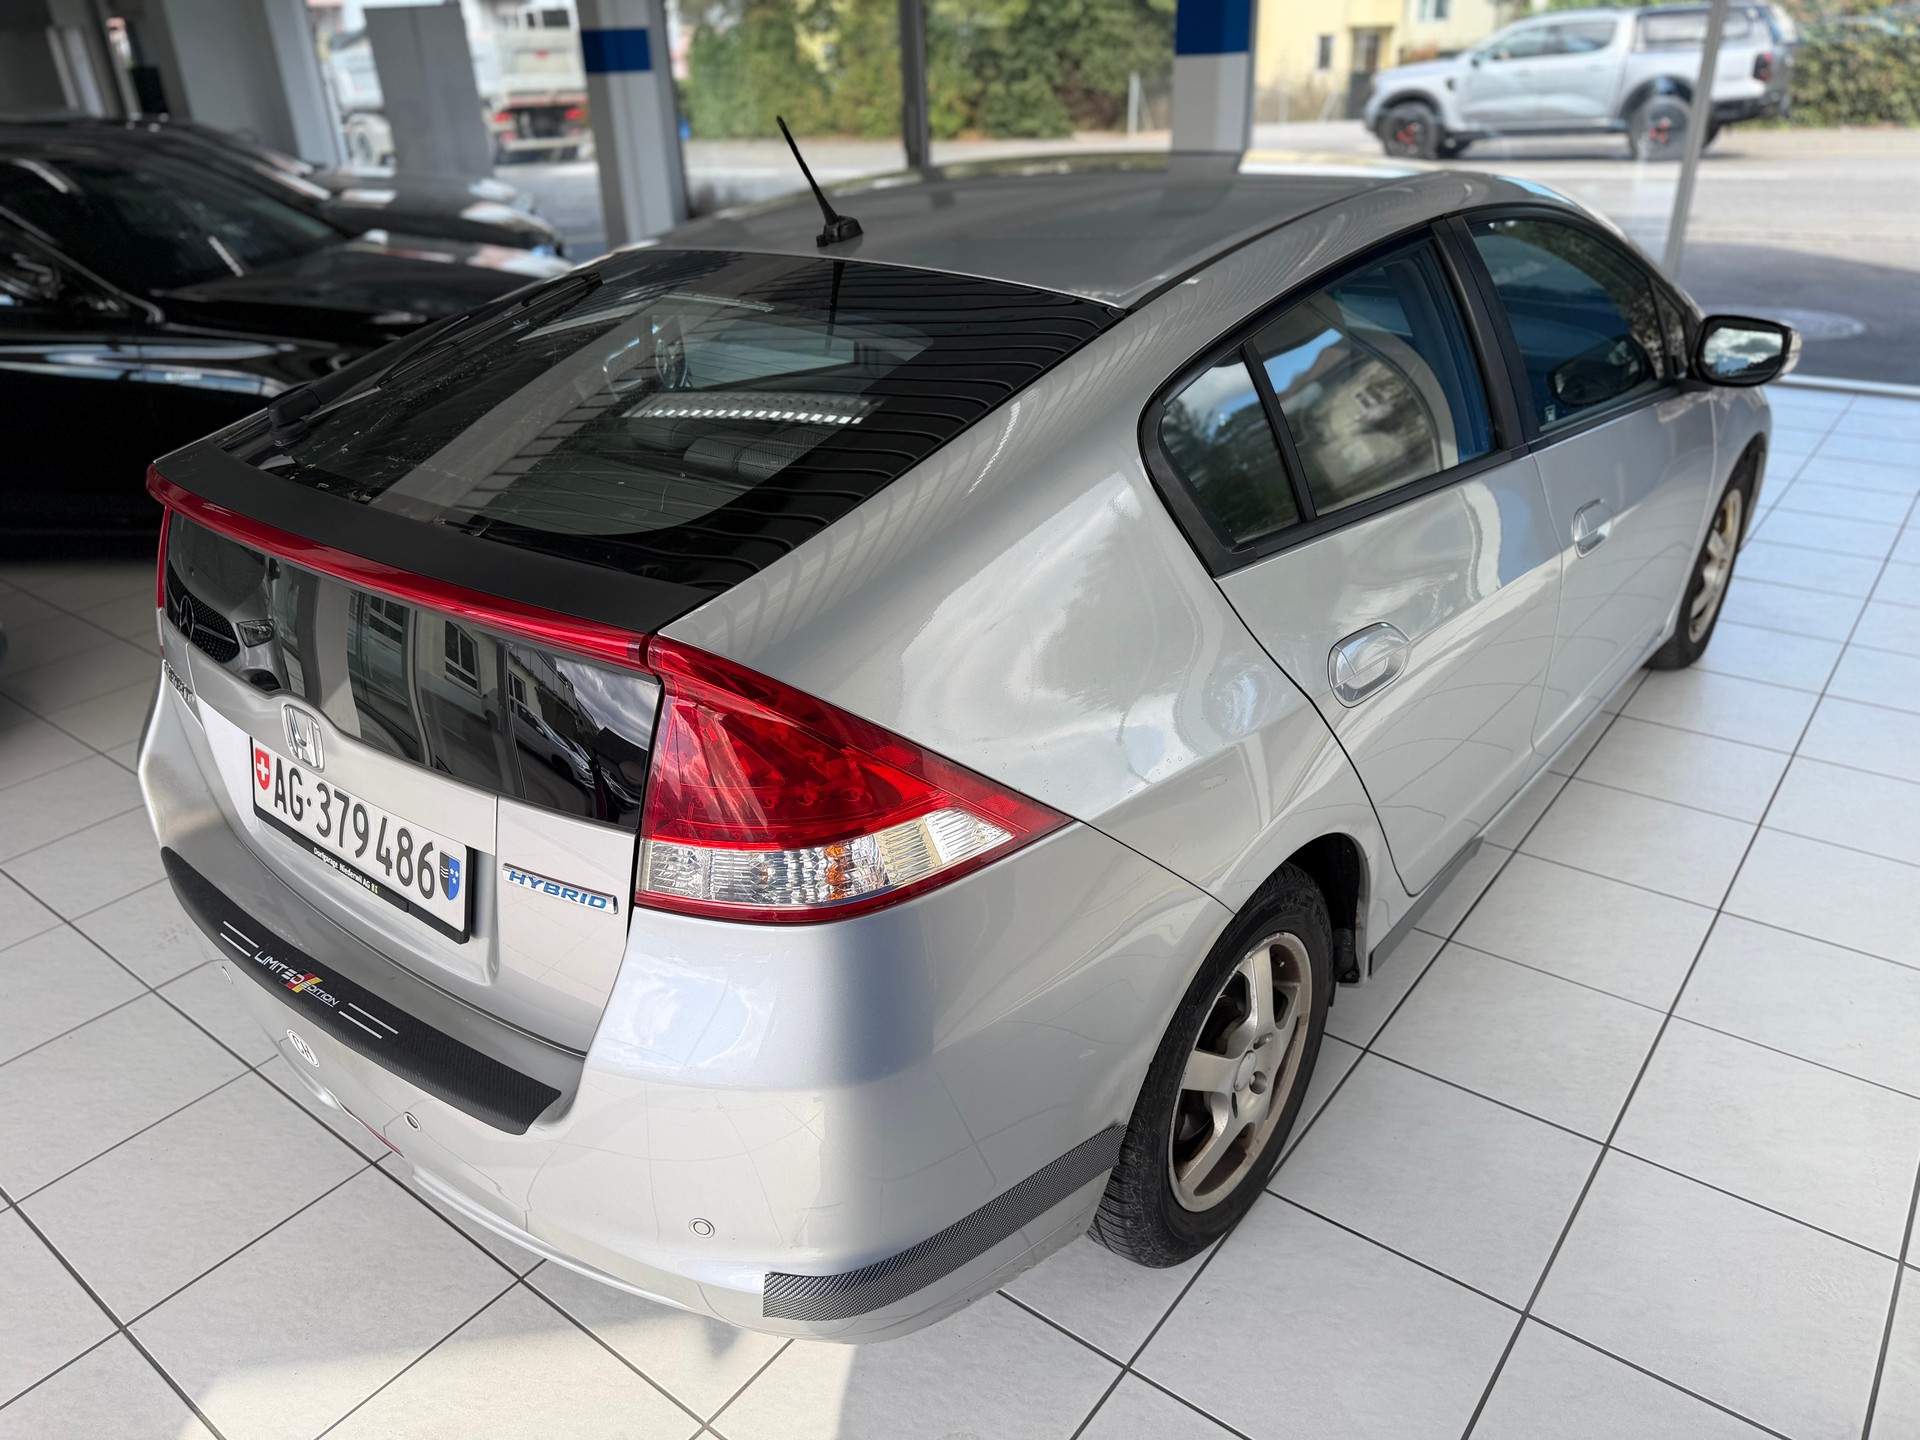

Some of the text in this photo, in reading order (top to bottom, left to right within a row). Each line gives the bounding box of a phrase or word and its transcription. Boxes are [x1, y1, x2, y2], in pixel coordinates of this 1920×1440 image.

[313, 847, 339, 869] Dorfgarage
[339, 863, 363, 883] Niederwil
[362, 878, 371, 889] AG
[508, 870, 607, 909] HYBRID
[254, 951, 340, 1006] LIMITED EDITION
[291, 1034, 315, 1063] CH
